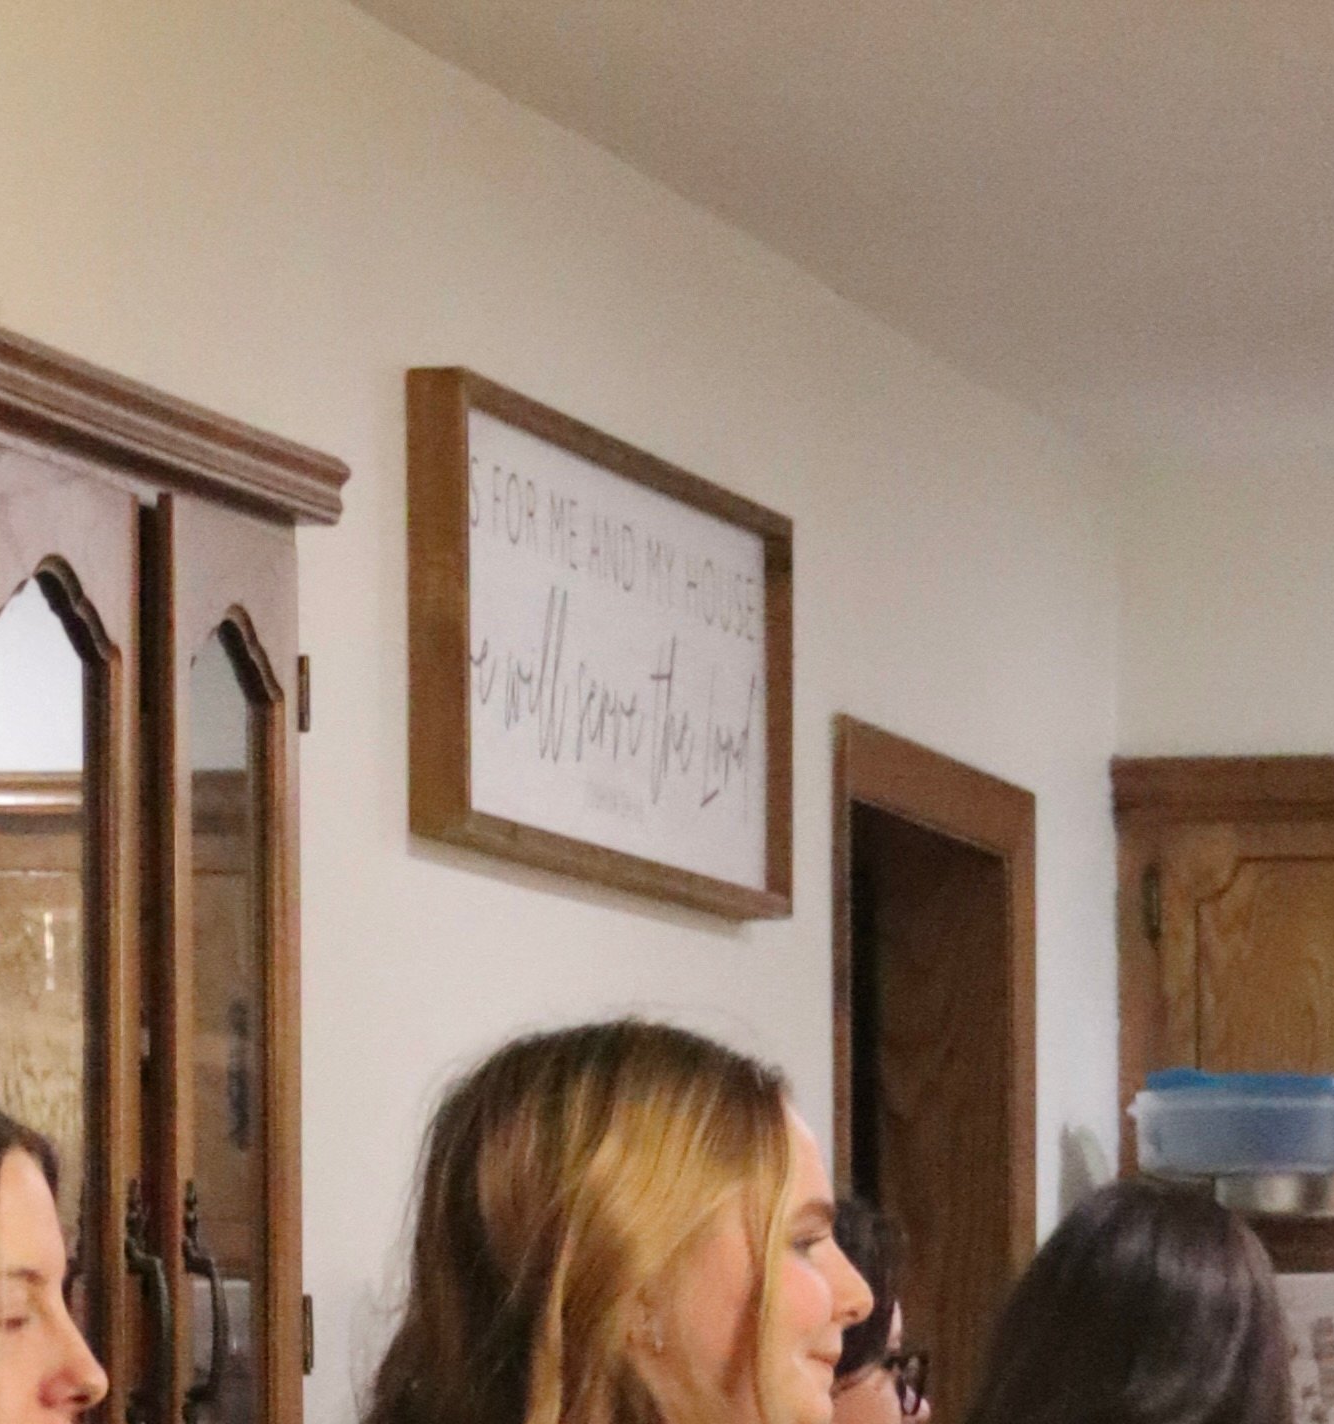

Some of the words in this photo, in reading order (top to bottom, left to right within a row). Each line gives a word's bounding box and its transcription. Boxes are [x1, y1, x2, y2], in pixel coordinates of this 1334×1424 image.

[492, 464, 538, 552] FOR
[549, 488, 579, 572] ME
[589, 512, 635, 593] AND
[647, 537, 677, 609] MY
[685, 551, 756, 642] HOUSE
[505, 584, 568, 764] will
[648, 634, 696, 806] the
